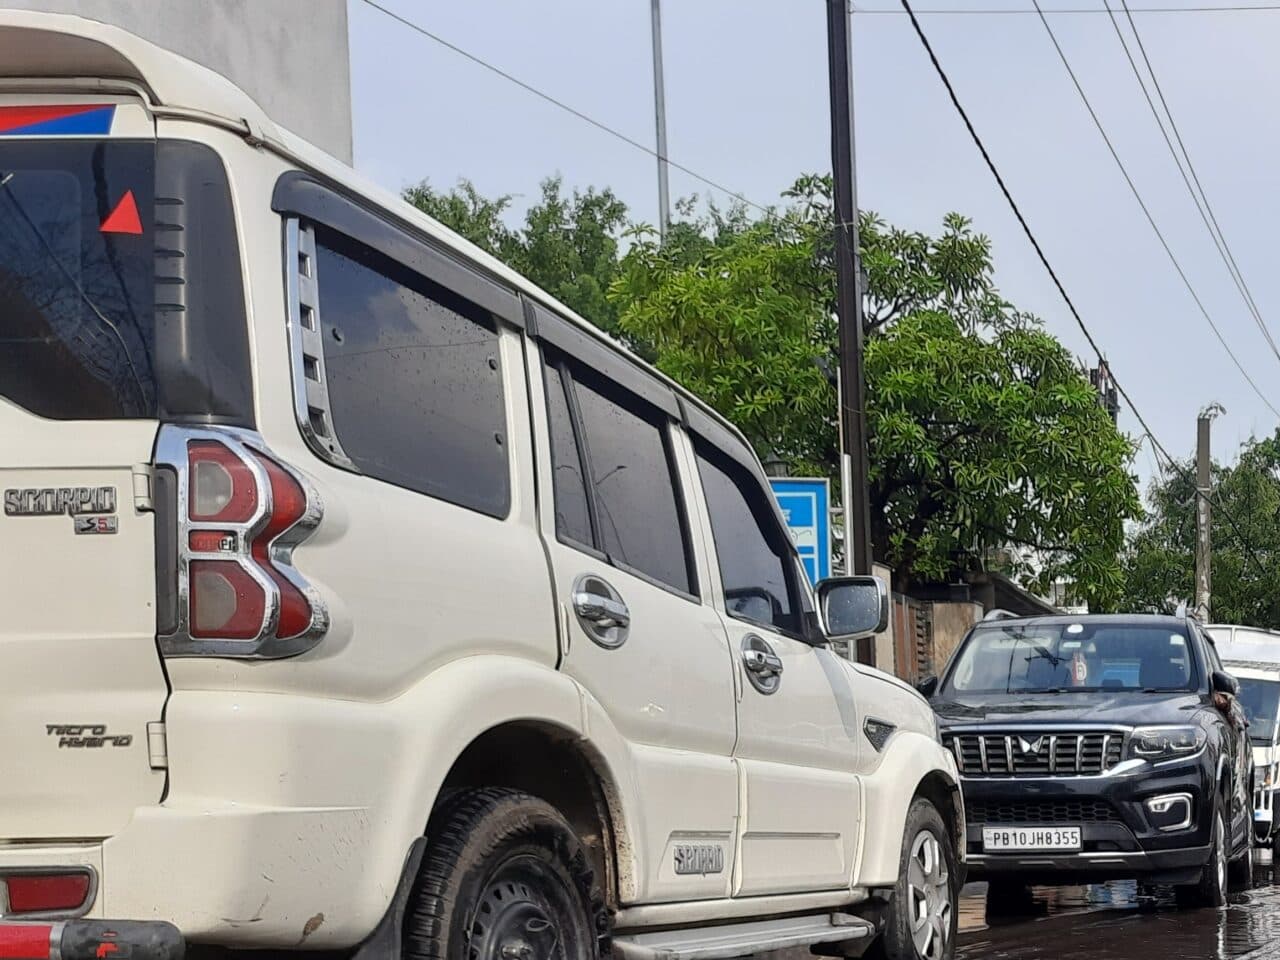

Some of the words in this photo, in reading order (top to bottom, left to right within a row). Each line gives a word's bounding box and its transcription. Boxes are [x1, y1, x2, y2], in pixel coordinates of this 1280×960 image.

[4, 486, 117, 518] SCORPIO
[80, 517, 108, 532] S5
[993, 831, 1079, 846] PB10JH8355
